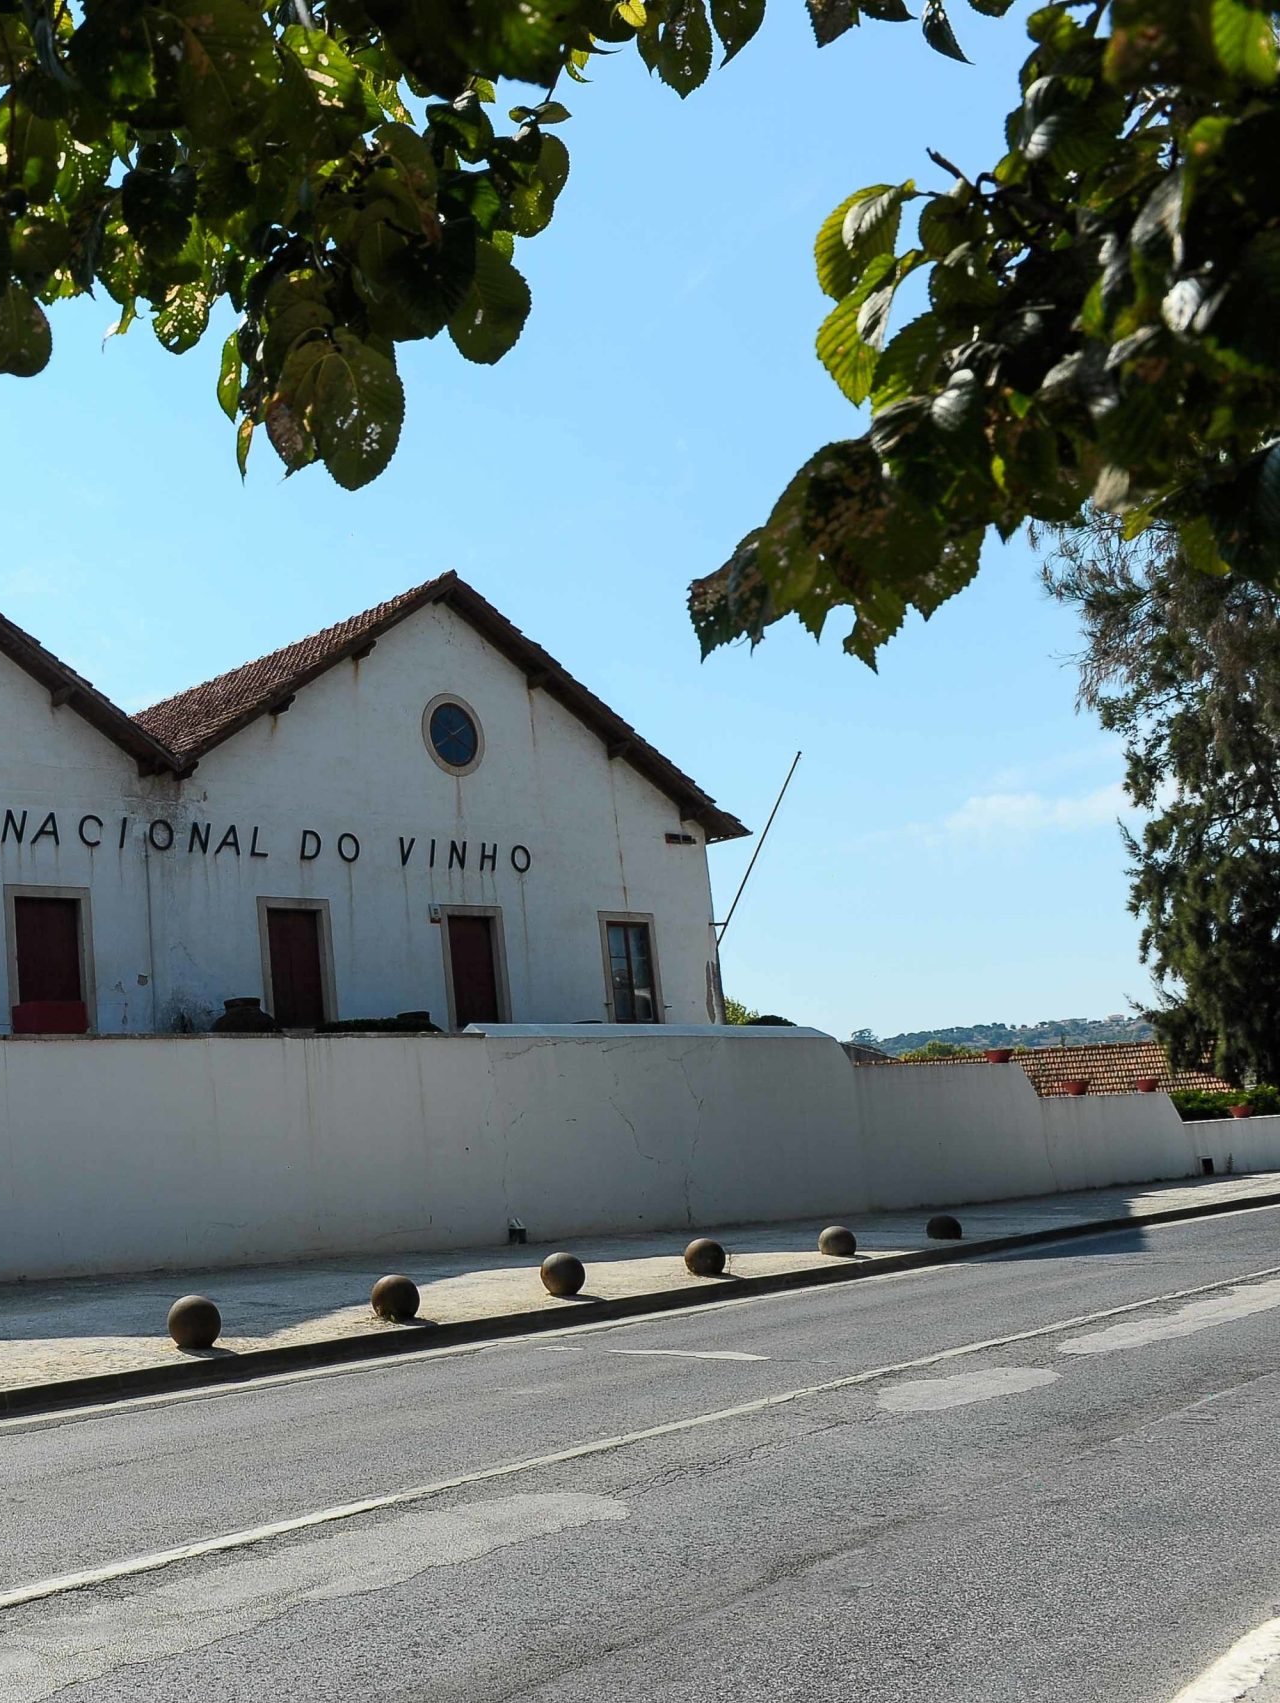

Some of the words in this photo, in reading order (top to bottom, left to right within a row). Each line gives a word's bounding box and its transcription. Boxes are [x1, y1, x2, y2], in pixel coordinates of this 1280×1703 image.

[1, 808, 269, 858] NACIONAL
[300, 829, 360, 863] DO
[399, 836, 531, 873] VINHO
